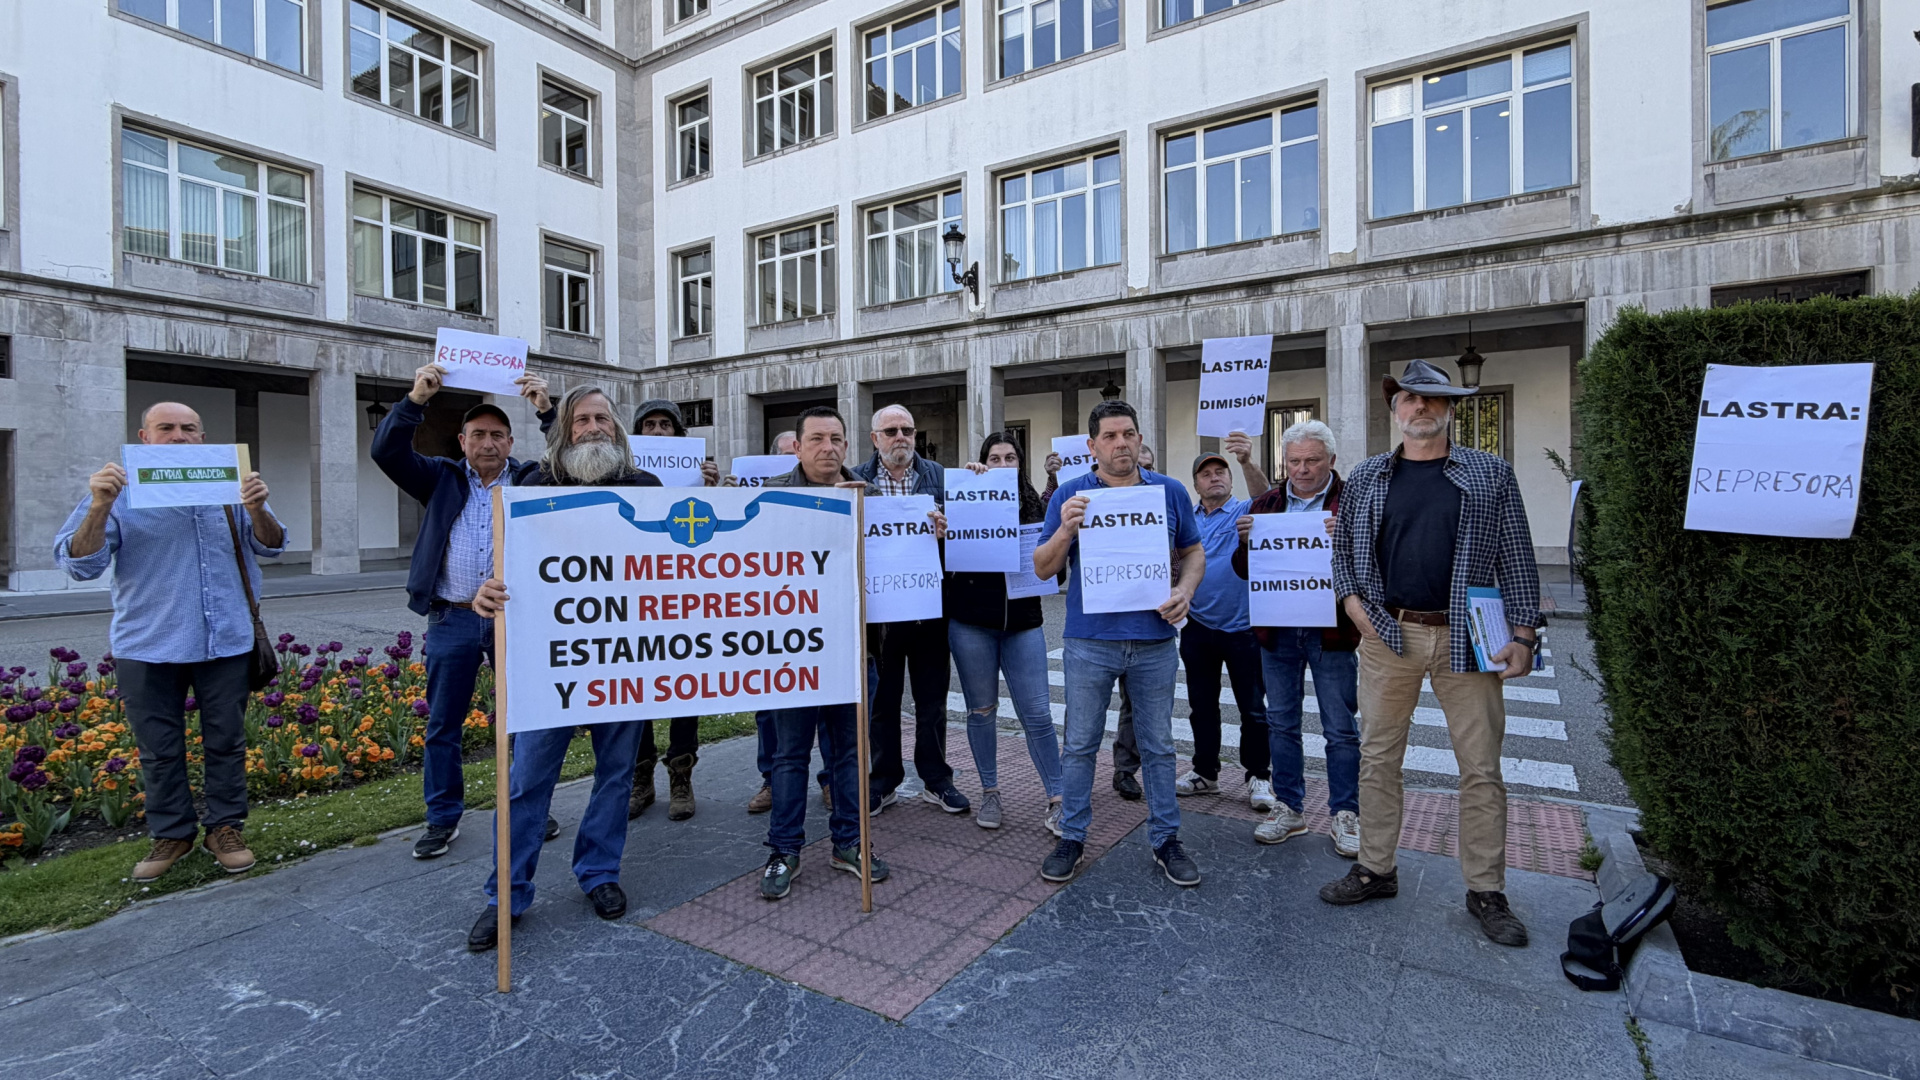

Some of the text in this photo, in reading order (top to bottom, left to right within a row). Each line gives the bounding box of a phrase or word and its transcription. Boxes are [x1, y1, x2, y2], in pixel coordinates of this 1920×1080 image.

[438, 345, 525, 370] REPRESORA
[1201, 358, 1268, 374] LASTRA:
[1200, 394, 1265, 410] DIMISIÓN
[1700, 400, 1860, 420] LASTRA:
[1694, 467, 1853, 499] REPRESORA
[945, 490, 1016, 502] LASTRA:
[864, 521, 935, 538] ASTRA:
[946, 526, 1018, 540] DIMISIÓN
[1248, 536, 1330, 551] LASTRA:
[538, 550, 831, 583] CON MERCOSUR Y
[1083, 562, 1169, 588] REPRESORA
[1250, 575, 1333, 592] DIMISIÓN
[554, 584, 819, 624] CON REPRESIÓN
[549, 627, 824, 668] ESTAMOS SOLOS
[554, 661, 820, 709] Y SIN SOLUCIÓN
